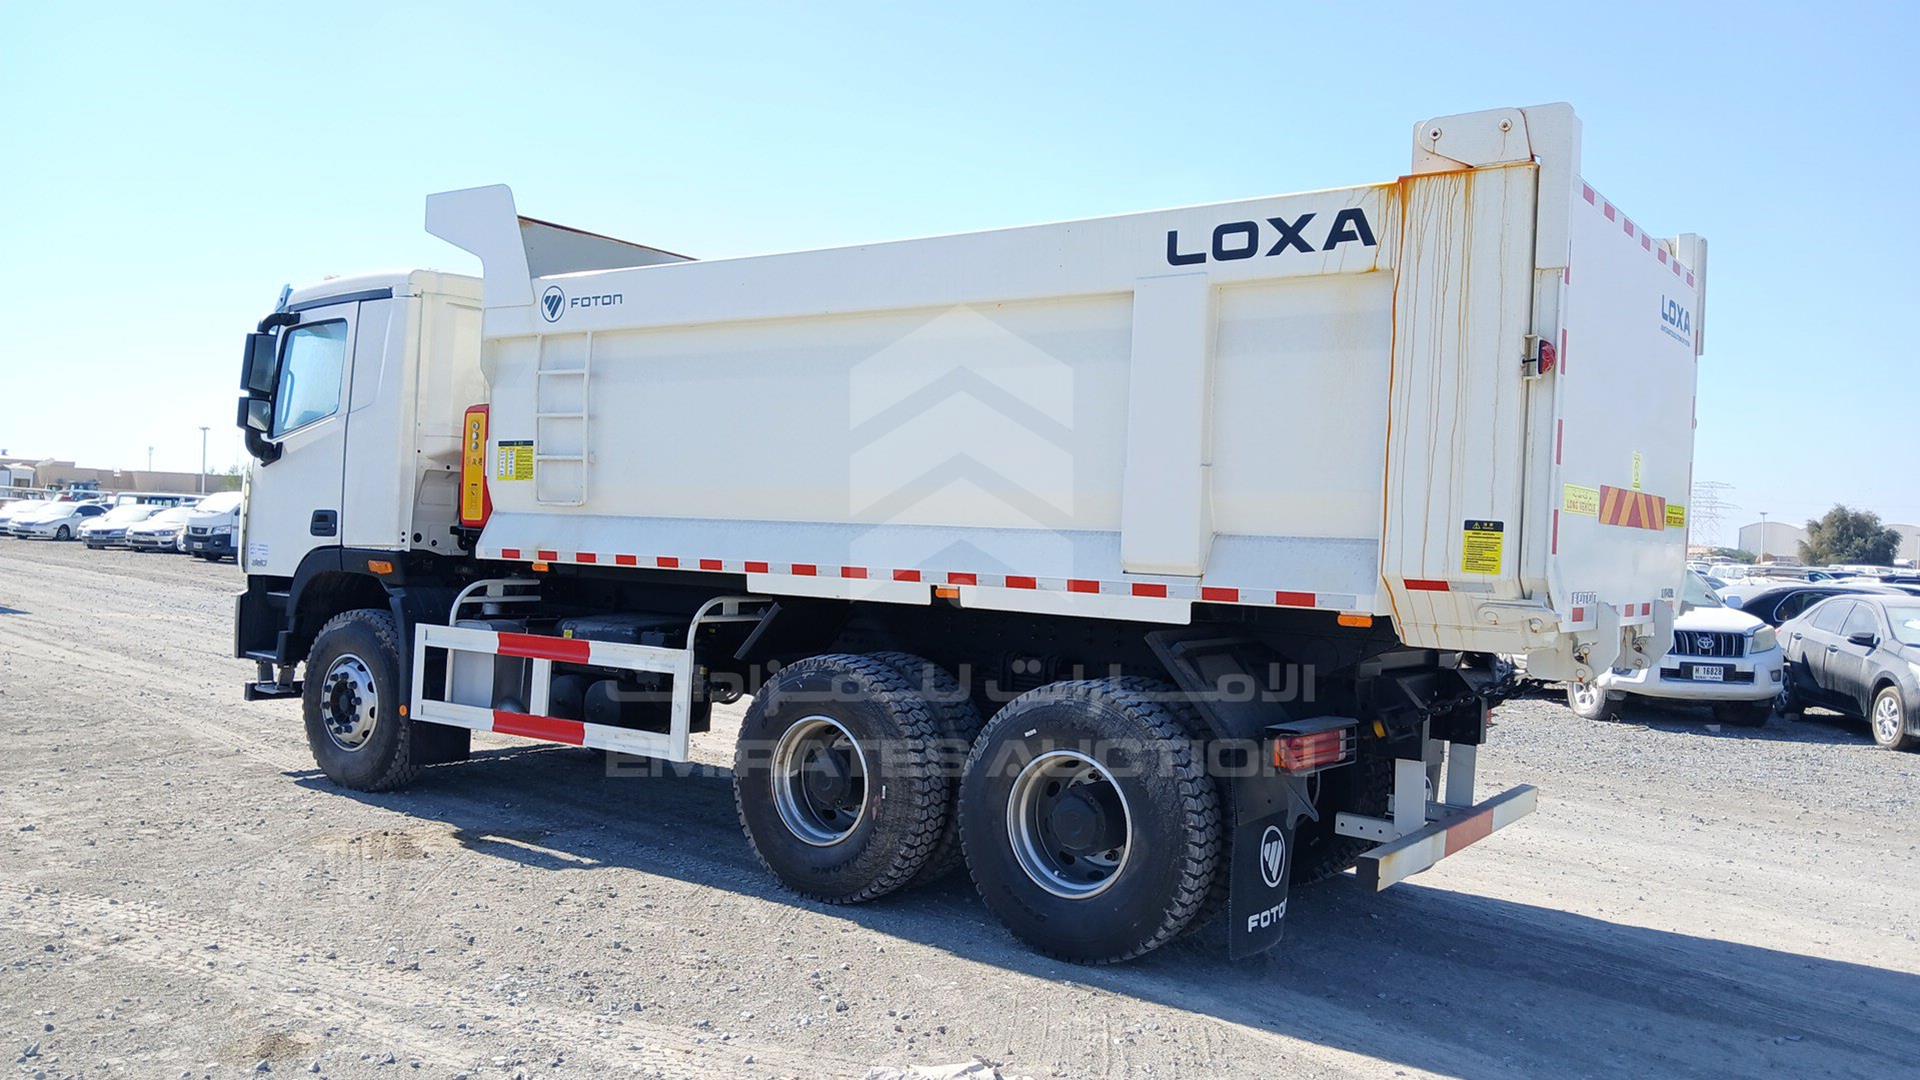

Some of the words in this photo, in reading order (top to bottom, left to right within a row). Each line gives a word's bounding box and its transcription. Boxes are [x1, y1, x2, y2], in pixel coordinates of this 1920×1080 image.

[1167, 207, 1377, 266] LOXA
[570, 293, 623, 308] FOTON
[1661, 294, 1690, 336] LOXA
[1247, 898, 1288, 933] FOTO
